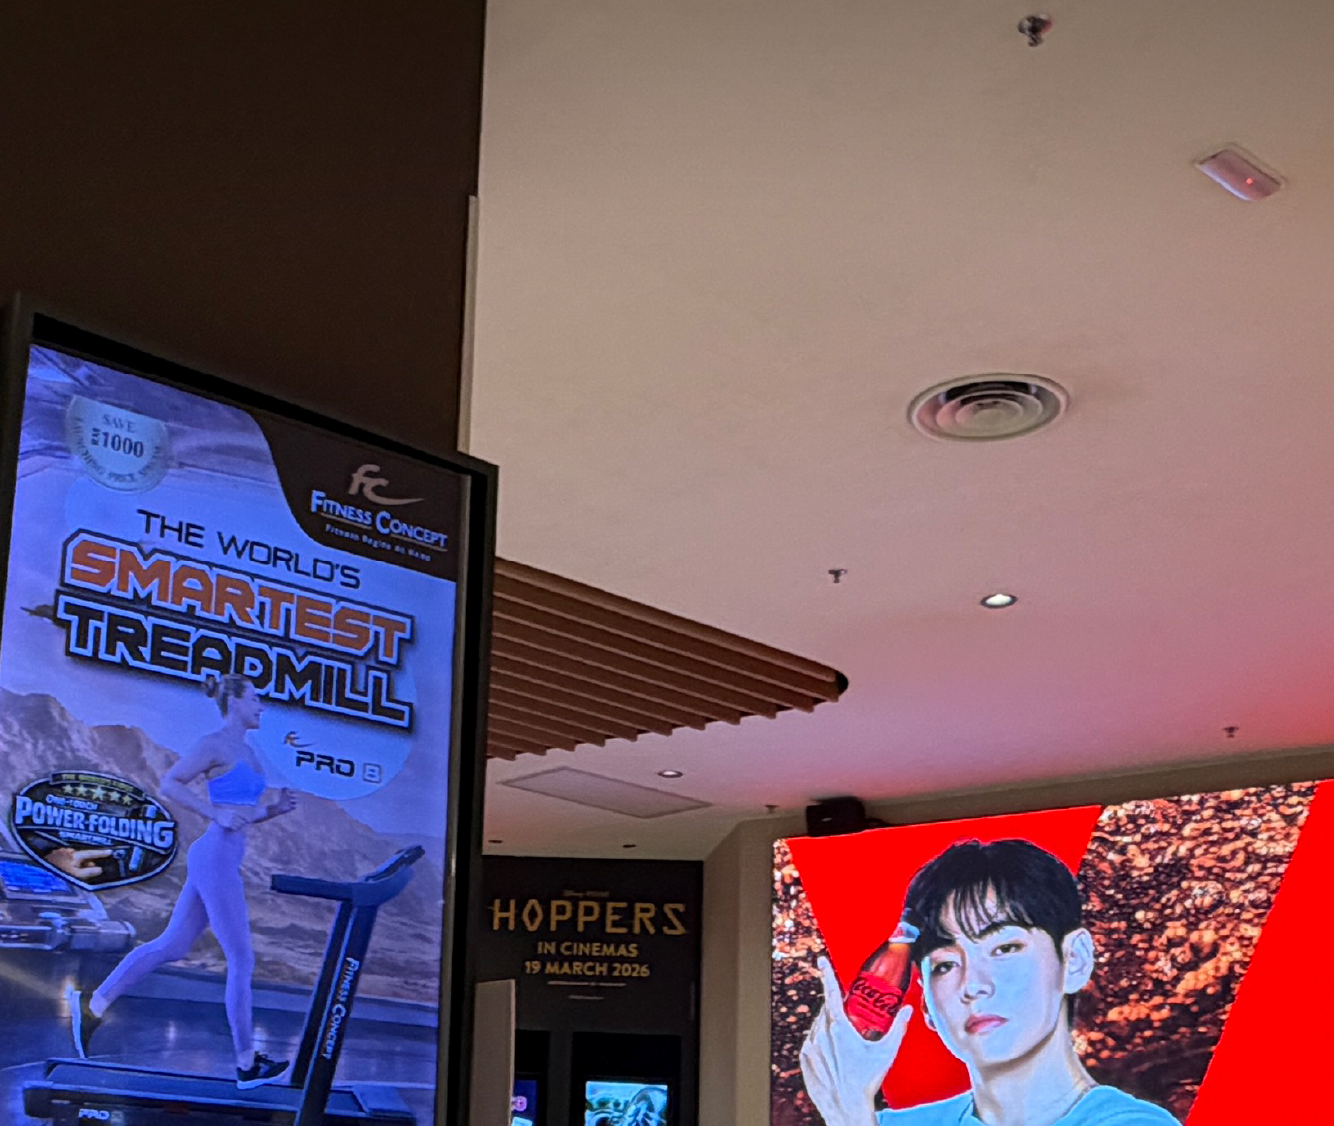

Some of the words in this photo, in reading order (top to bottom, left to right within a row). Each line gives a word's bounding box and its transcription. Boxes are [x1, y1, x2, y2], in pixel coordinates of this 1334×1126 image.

[102, 413, 136, 434] SAVE
[101, 431, 144, 458] 1000
[310, 489, 373, 526] FITNESS
[375, 510, 448, 548] CONCEPT
[137, 508, 207, 549] THE
[217, 531, 361, 590] WORLD'S
[67, 537, 409, 662] SMARTEST
[61, 600, 413, 730] TREADMILL
[295, 750, 355, 778] PRO
[15, 795, 175, 849] POWER-FOLDING
[492, 898, 687, 935] HOPPERS
[537, 941, 555, 956] IN
[560, 941, 638, 958] CINEMAS
[525, 961, 541, 975] 19
[545, 961, 608, 976] MARCH
[612, 963, 650, 978] 2026
